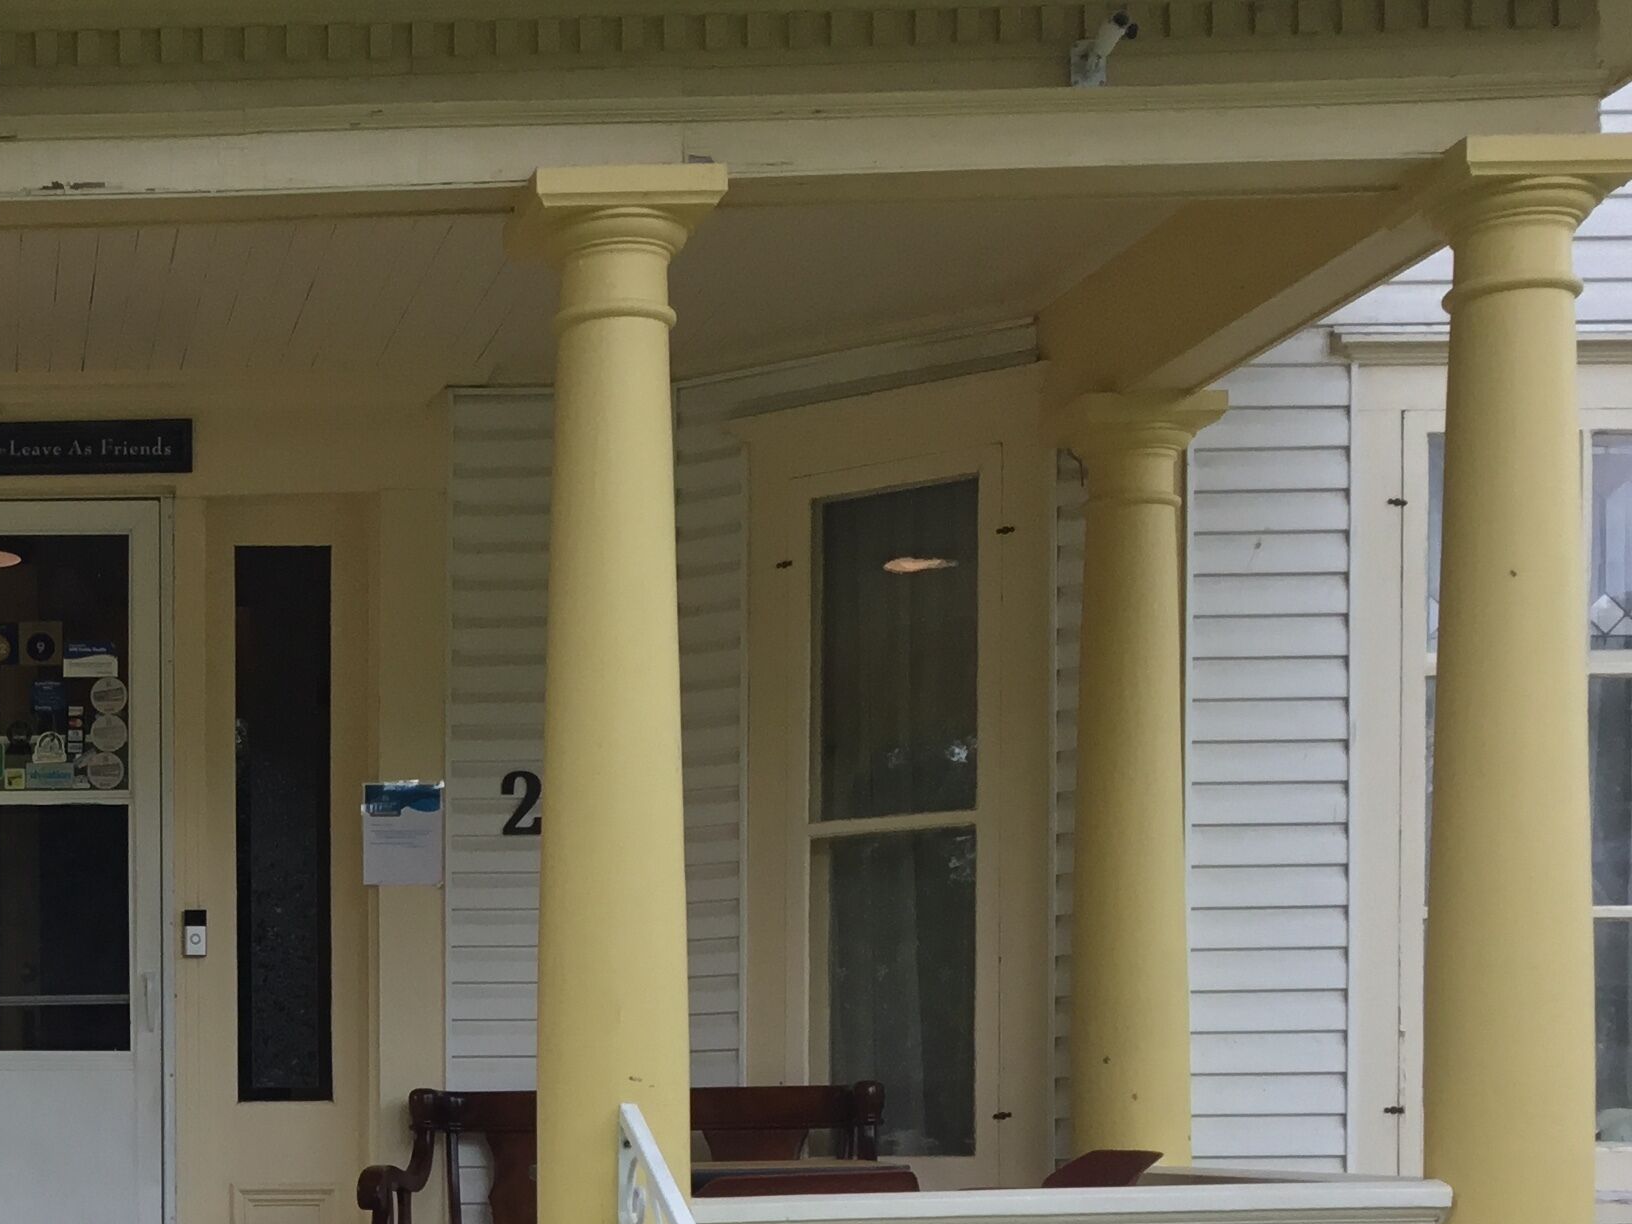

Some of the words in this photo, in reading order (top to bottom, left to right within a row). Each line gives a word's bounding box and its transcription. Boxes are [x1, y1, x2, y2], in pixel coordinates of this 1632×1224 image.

[9, 439, 62, 457] Leave
[69, 439, 93, 456] As
[100, 436, 173, 456] Friends
[36, 641, 46, 654] 9
[500, 770, 542, 836] 2
